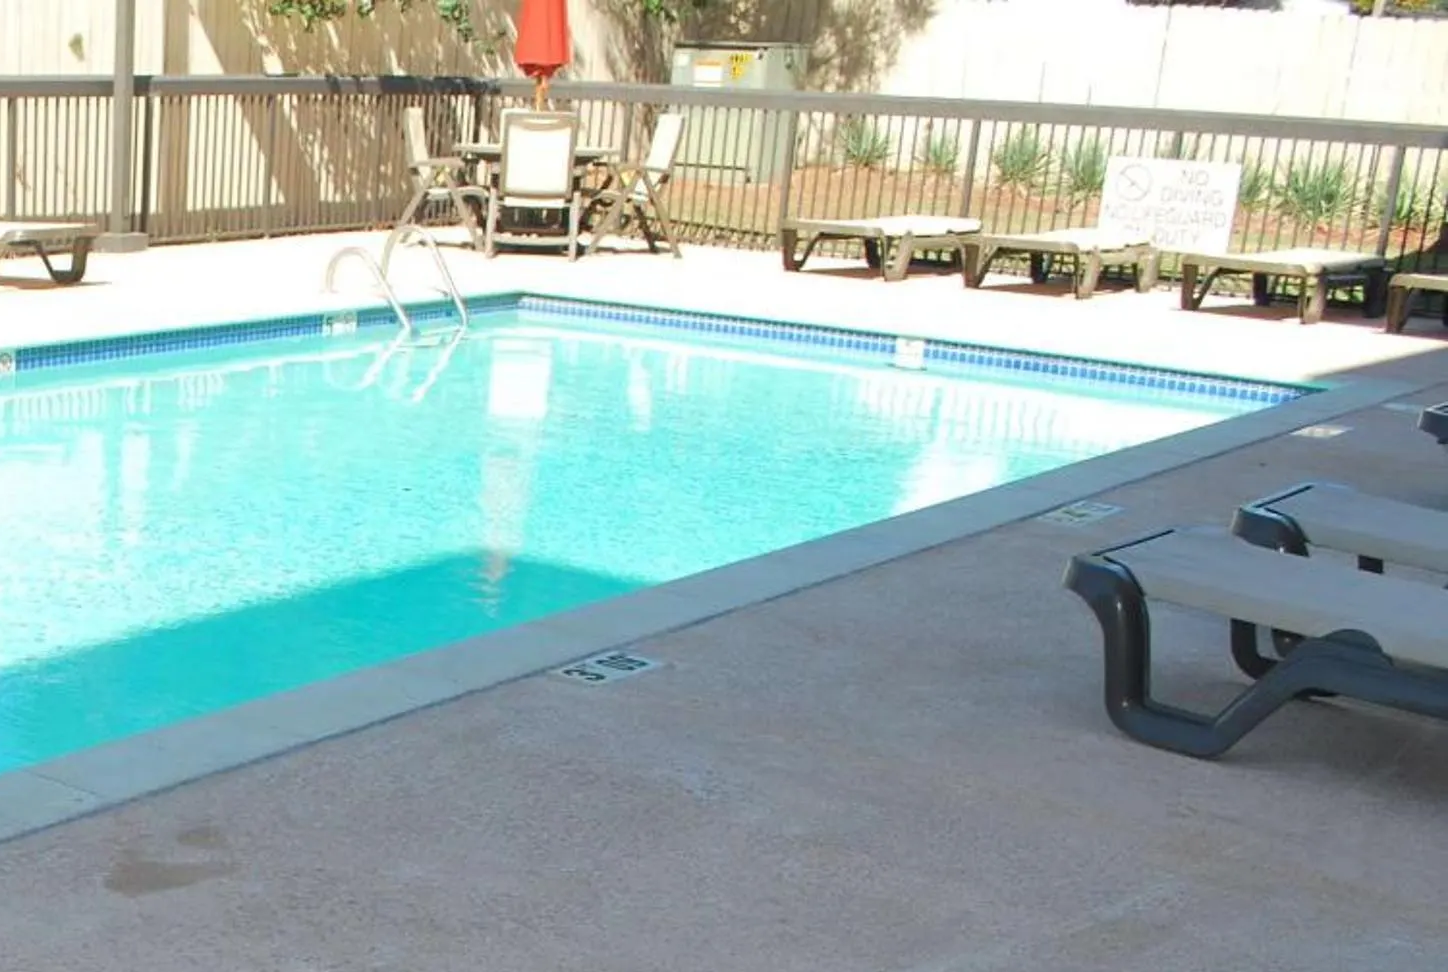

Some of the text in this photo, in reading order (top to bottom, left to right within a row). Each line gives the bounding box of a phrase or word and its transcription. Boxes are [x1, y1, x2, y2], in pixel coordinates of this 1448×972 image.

[1180, 169, 1210, 187] NO
[1160, 186, 1224, 207] DIVING
[1154, 227, 1200, 245] DUTY
